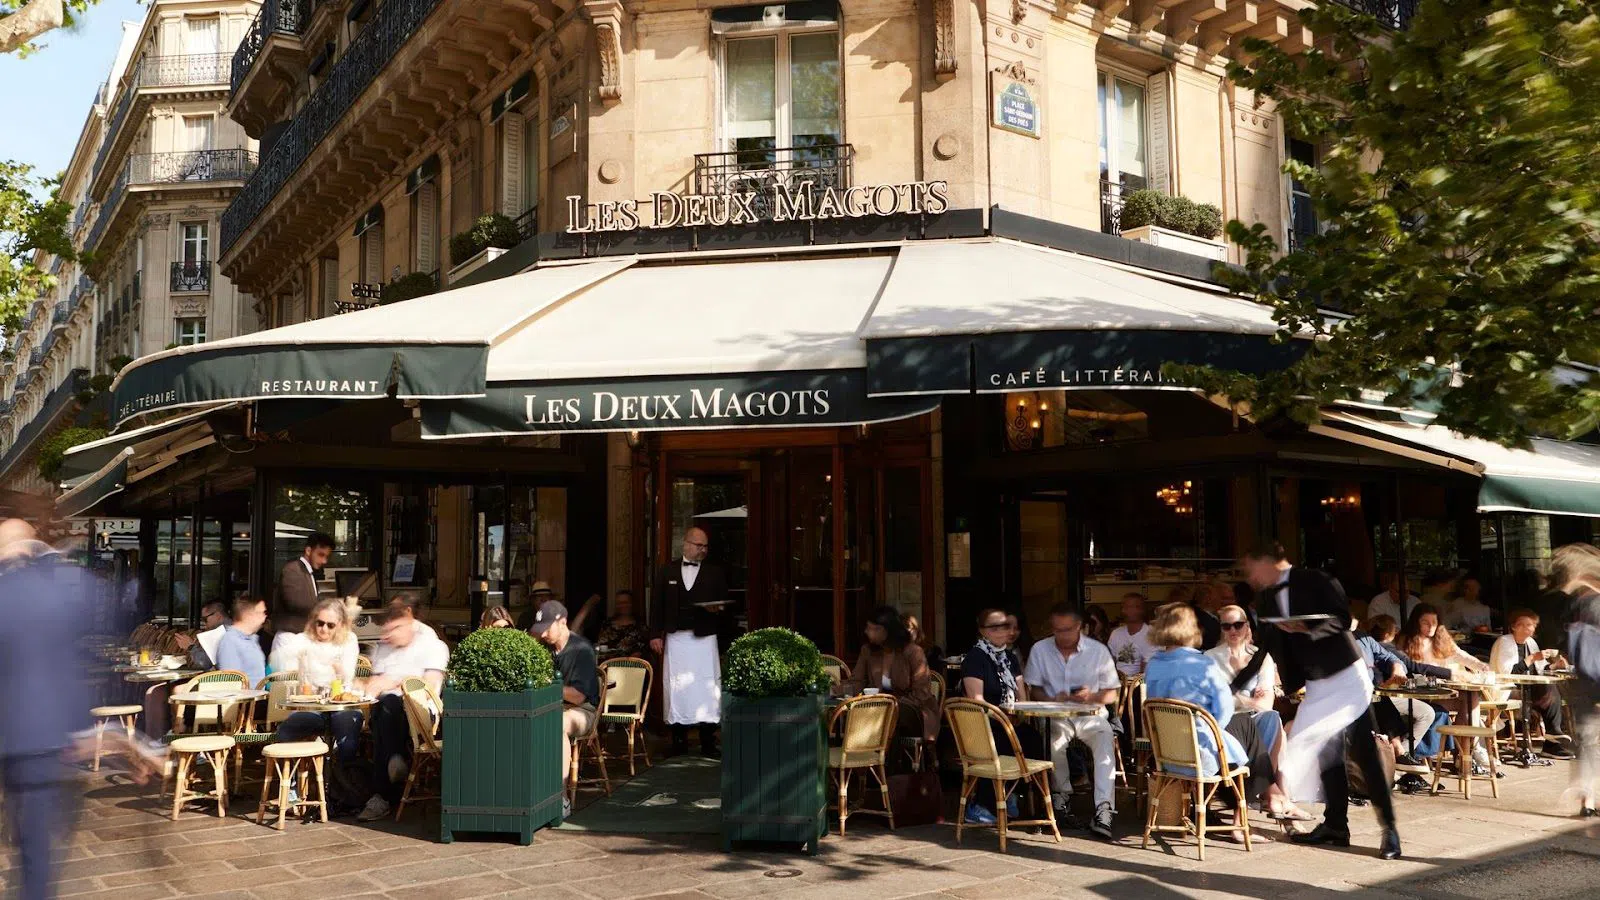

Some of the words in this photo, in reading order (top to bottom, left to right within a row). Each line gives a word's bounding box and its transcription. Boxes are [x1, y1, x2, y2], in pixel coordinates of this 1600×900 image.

[566, 195, 641, 233] LES
[649, 190, 759, 229] DEUX
[772, 180, 949, 221] MAGOTS
[261, 380, 379, 393] RESTAURANT
[990, 367, 1046, 386] CAFÉ
[1060, 365, 1185, 384] LITTÉRAI
[523, 394, 581, 425] LES
[591, 391, 682, 422] DEUX
[688, 387, 830, 419] MAGOTS
